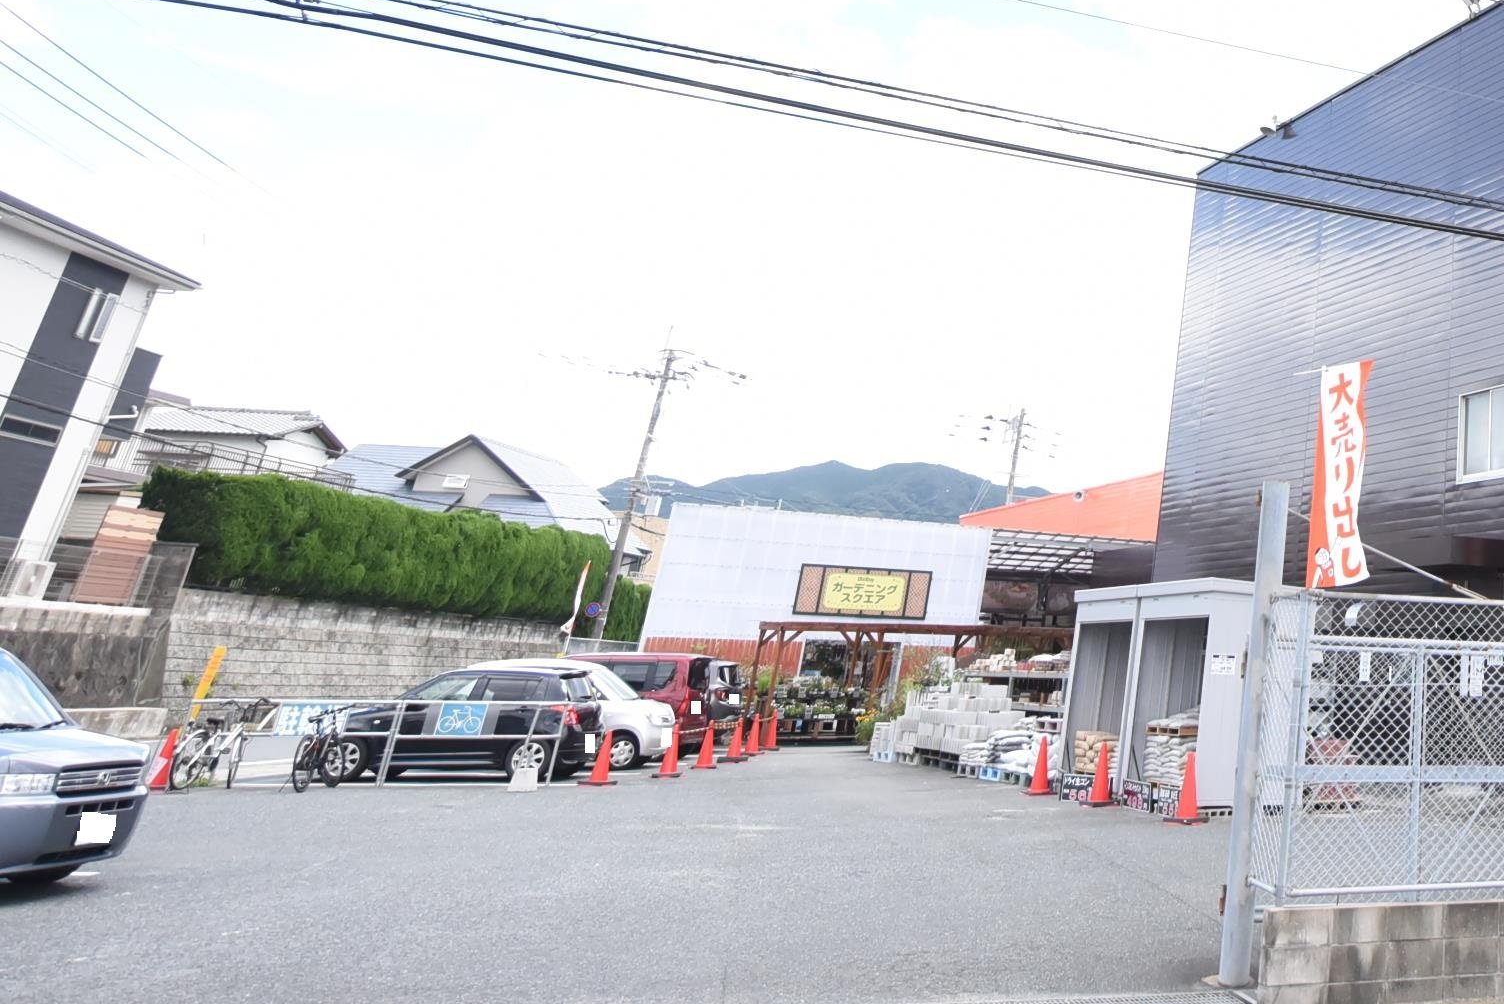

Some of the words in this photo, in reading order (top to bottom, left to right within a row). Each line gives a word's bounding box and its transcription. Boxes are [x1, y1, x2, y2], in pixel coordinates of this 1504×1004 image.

[1328, 373, 1362, 578] 大売り出し
[832, 581, 898, 596] ガーデニング
[841, 592, 886, 604] スクエア
